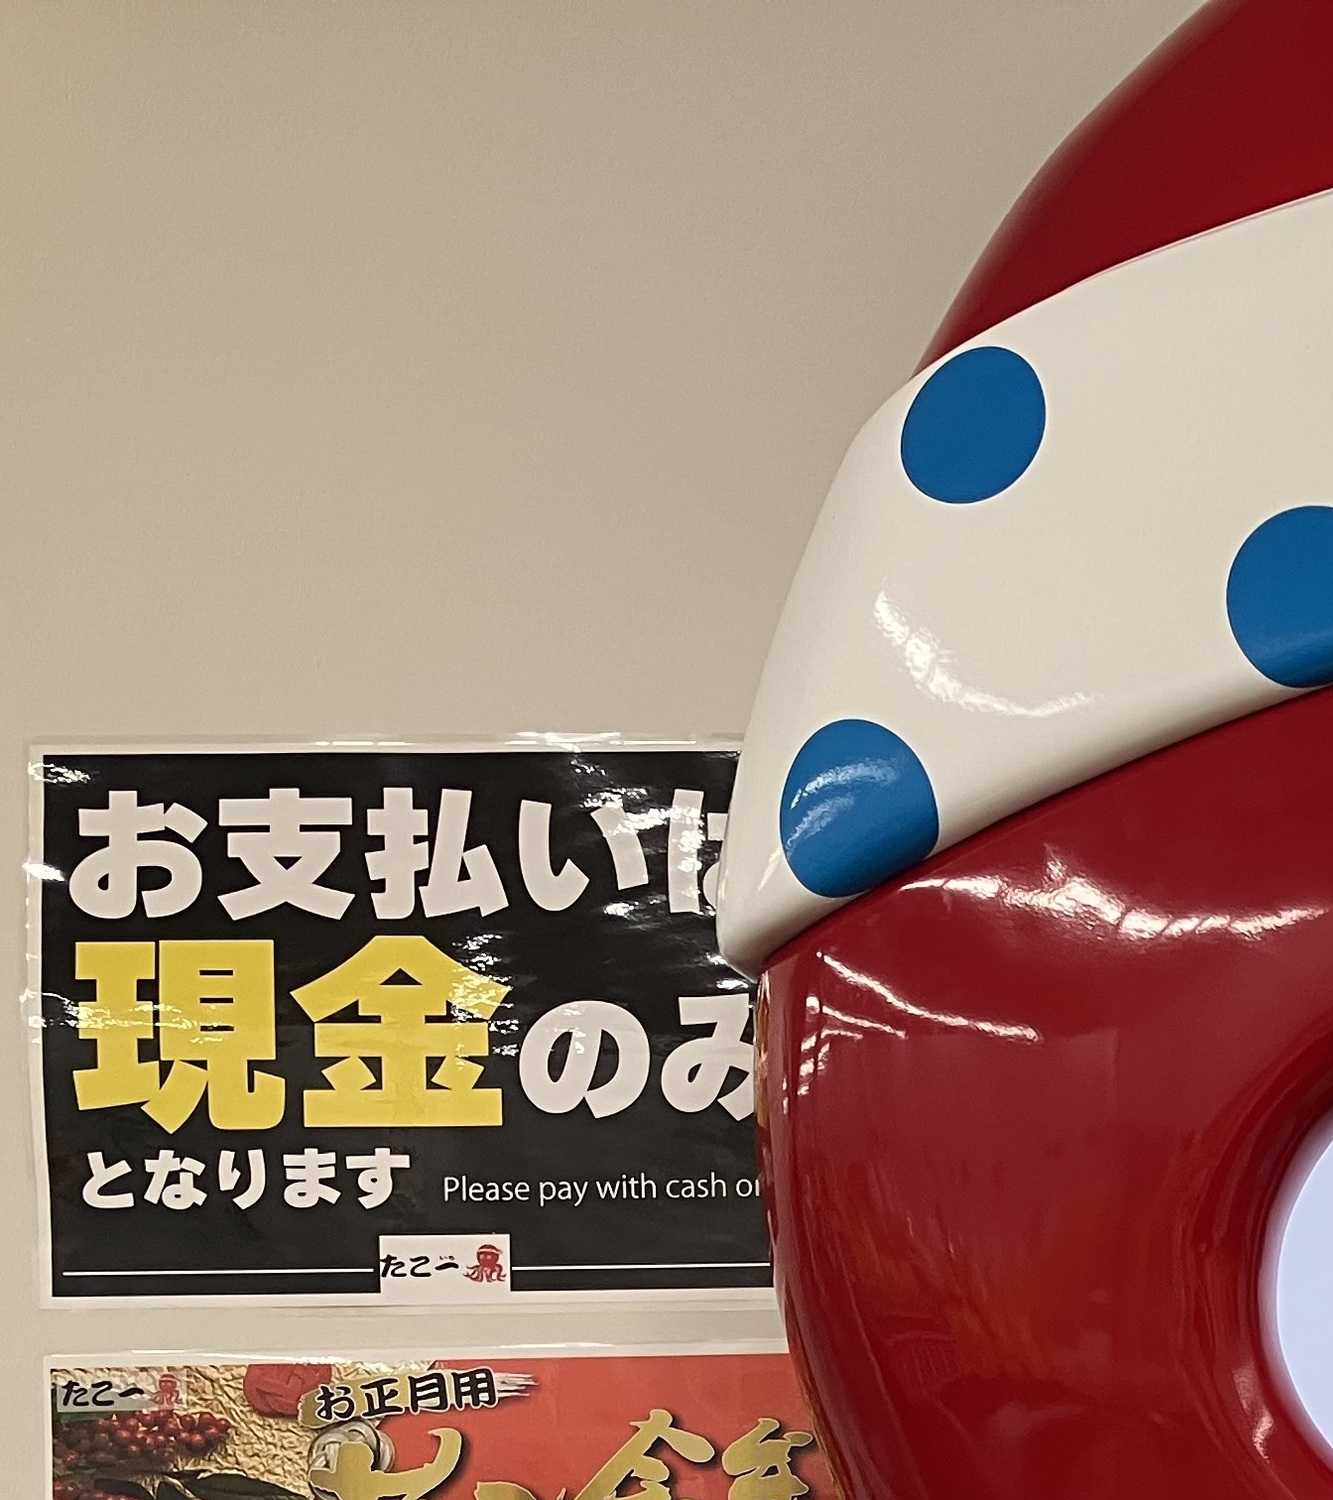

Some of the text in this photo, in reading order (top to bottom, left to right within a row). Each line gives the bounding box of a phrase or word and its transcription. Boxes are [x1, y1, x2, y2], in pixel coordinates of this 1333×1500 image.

[80, 1147, 411, 1210] となります
[444, 1175, 530, 1202] Please
[539, 1179, 588, 1207] pay
[596, 1173, 657, 1199] with
[666, 1172, 727, 1198] cash
[313, 1368, 499, 1421] お正月用
